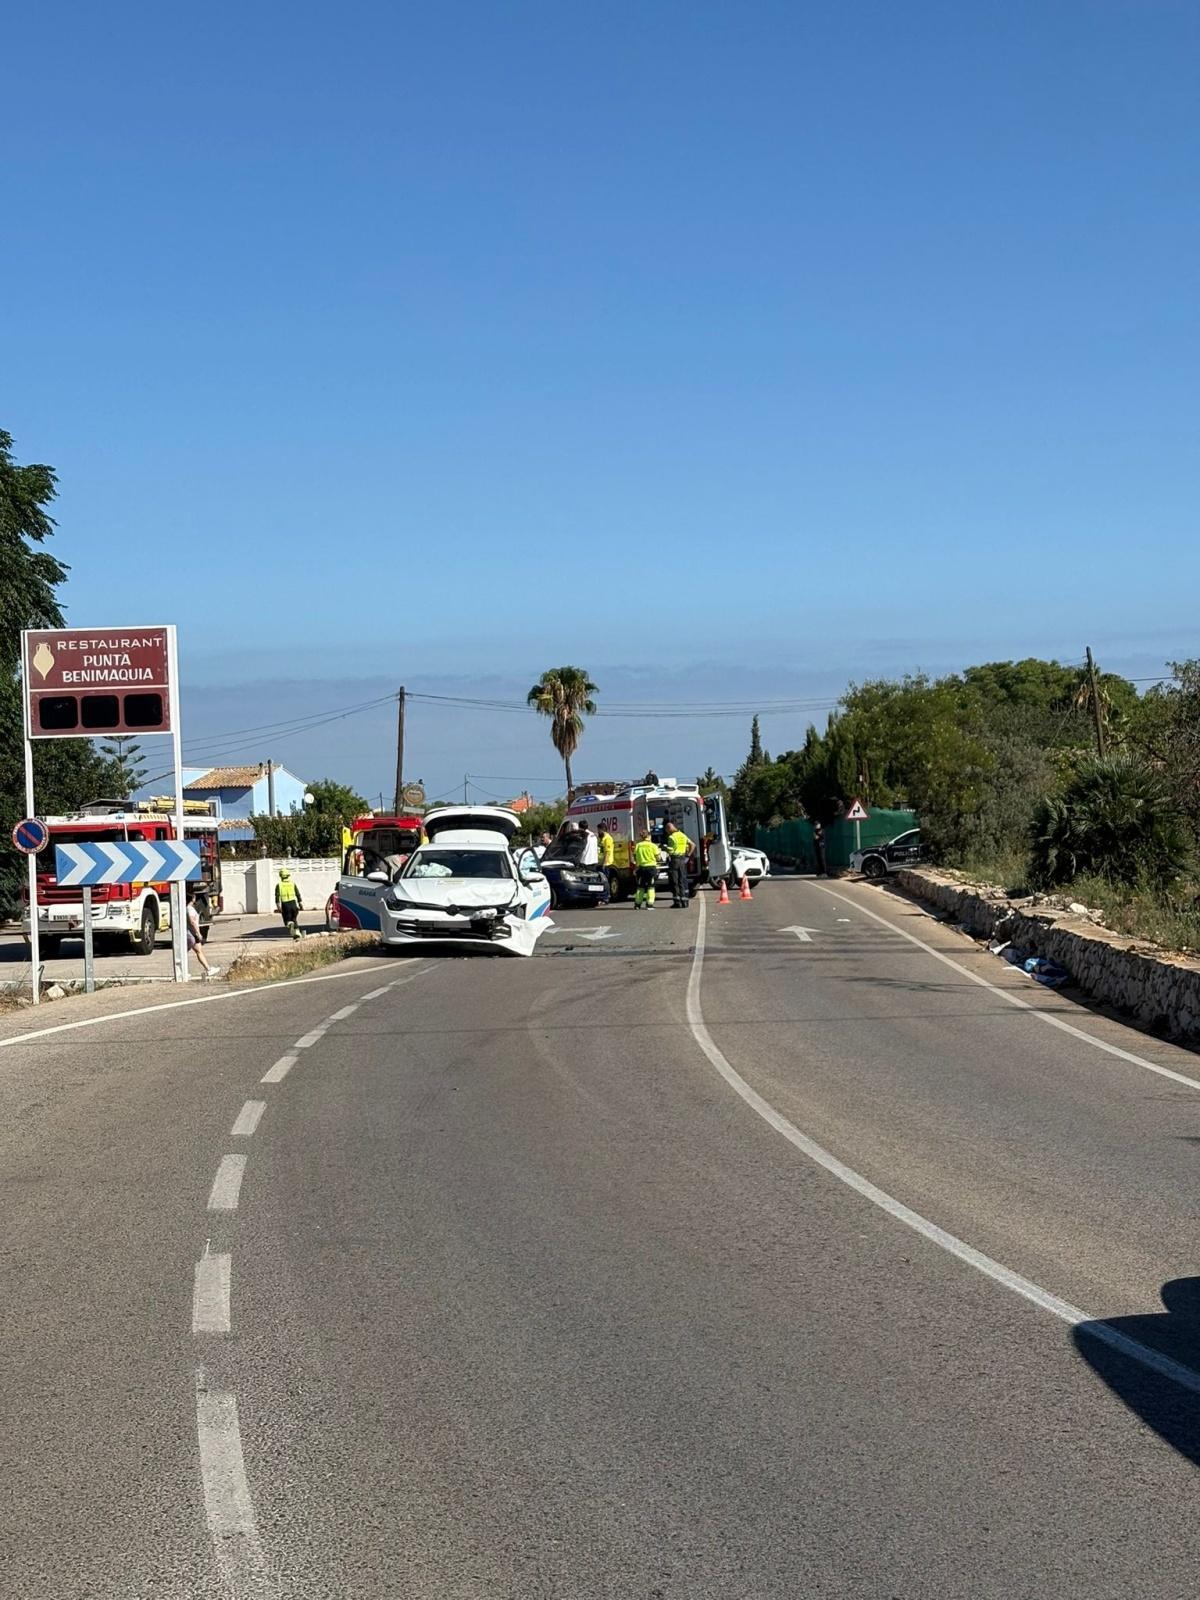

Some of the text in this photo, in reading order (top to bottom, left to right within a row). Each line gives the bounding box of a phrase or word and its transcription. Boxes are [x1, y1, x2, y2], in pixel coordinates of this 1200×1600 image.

[57, 638, 162, 650] RESTAURANT
[83, 654, 131, 667] PUNTA
[62, 668, 154, 683] BENIMAQUIA
